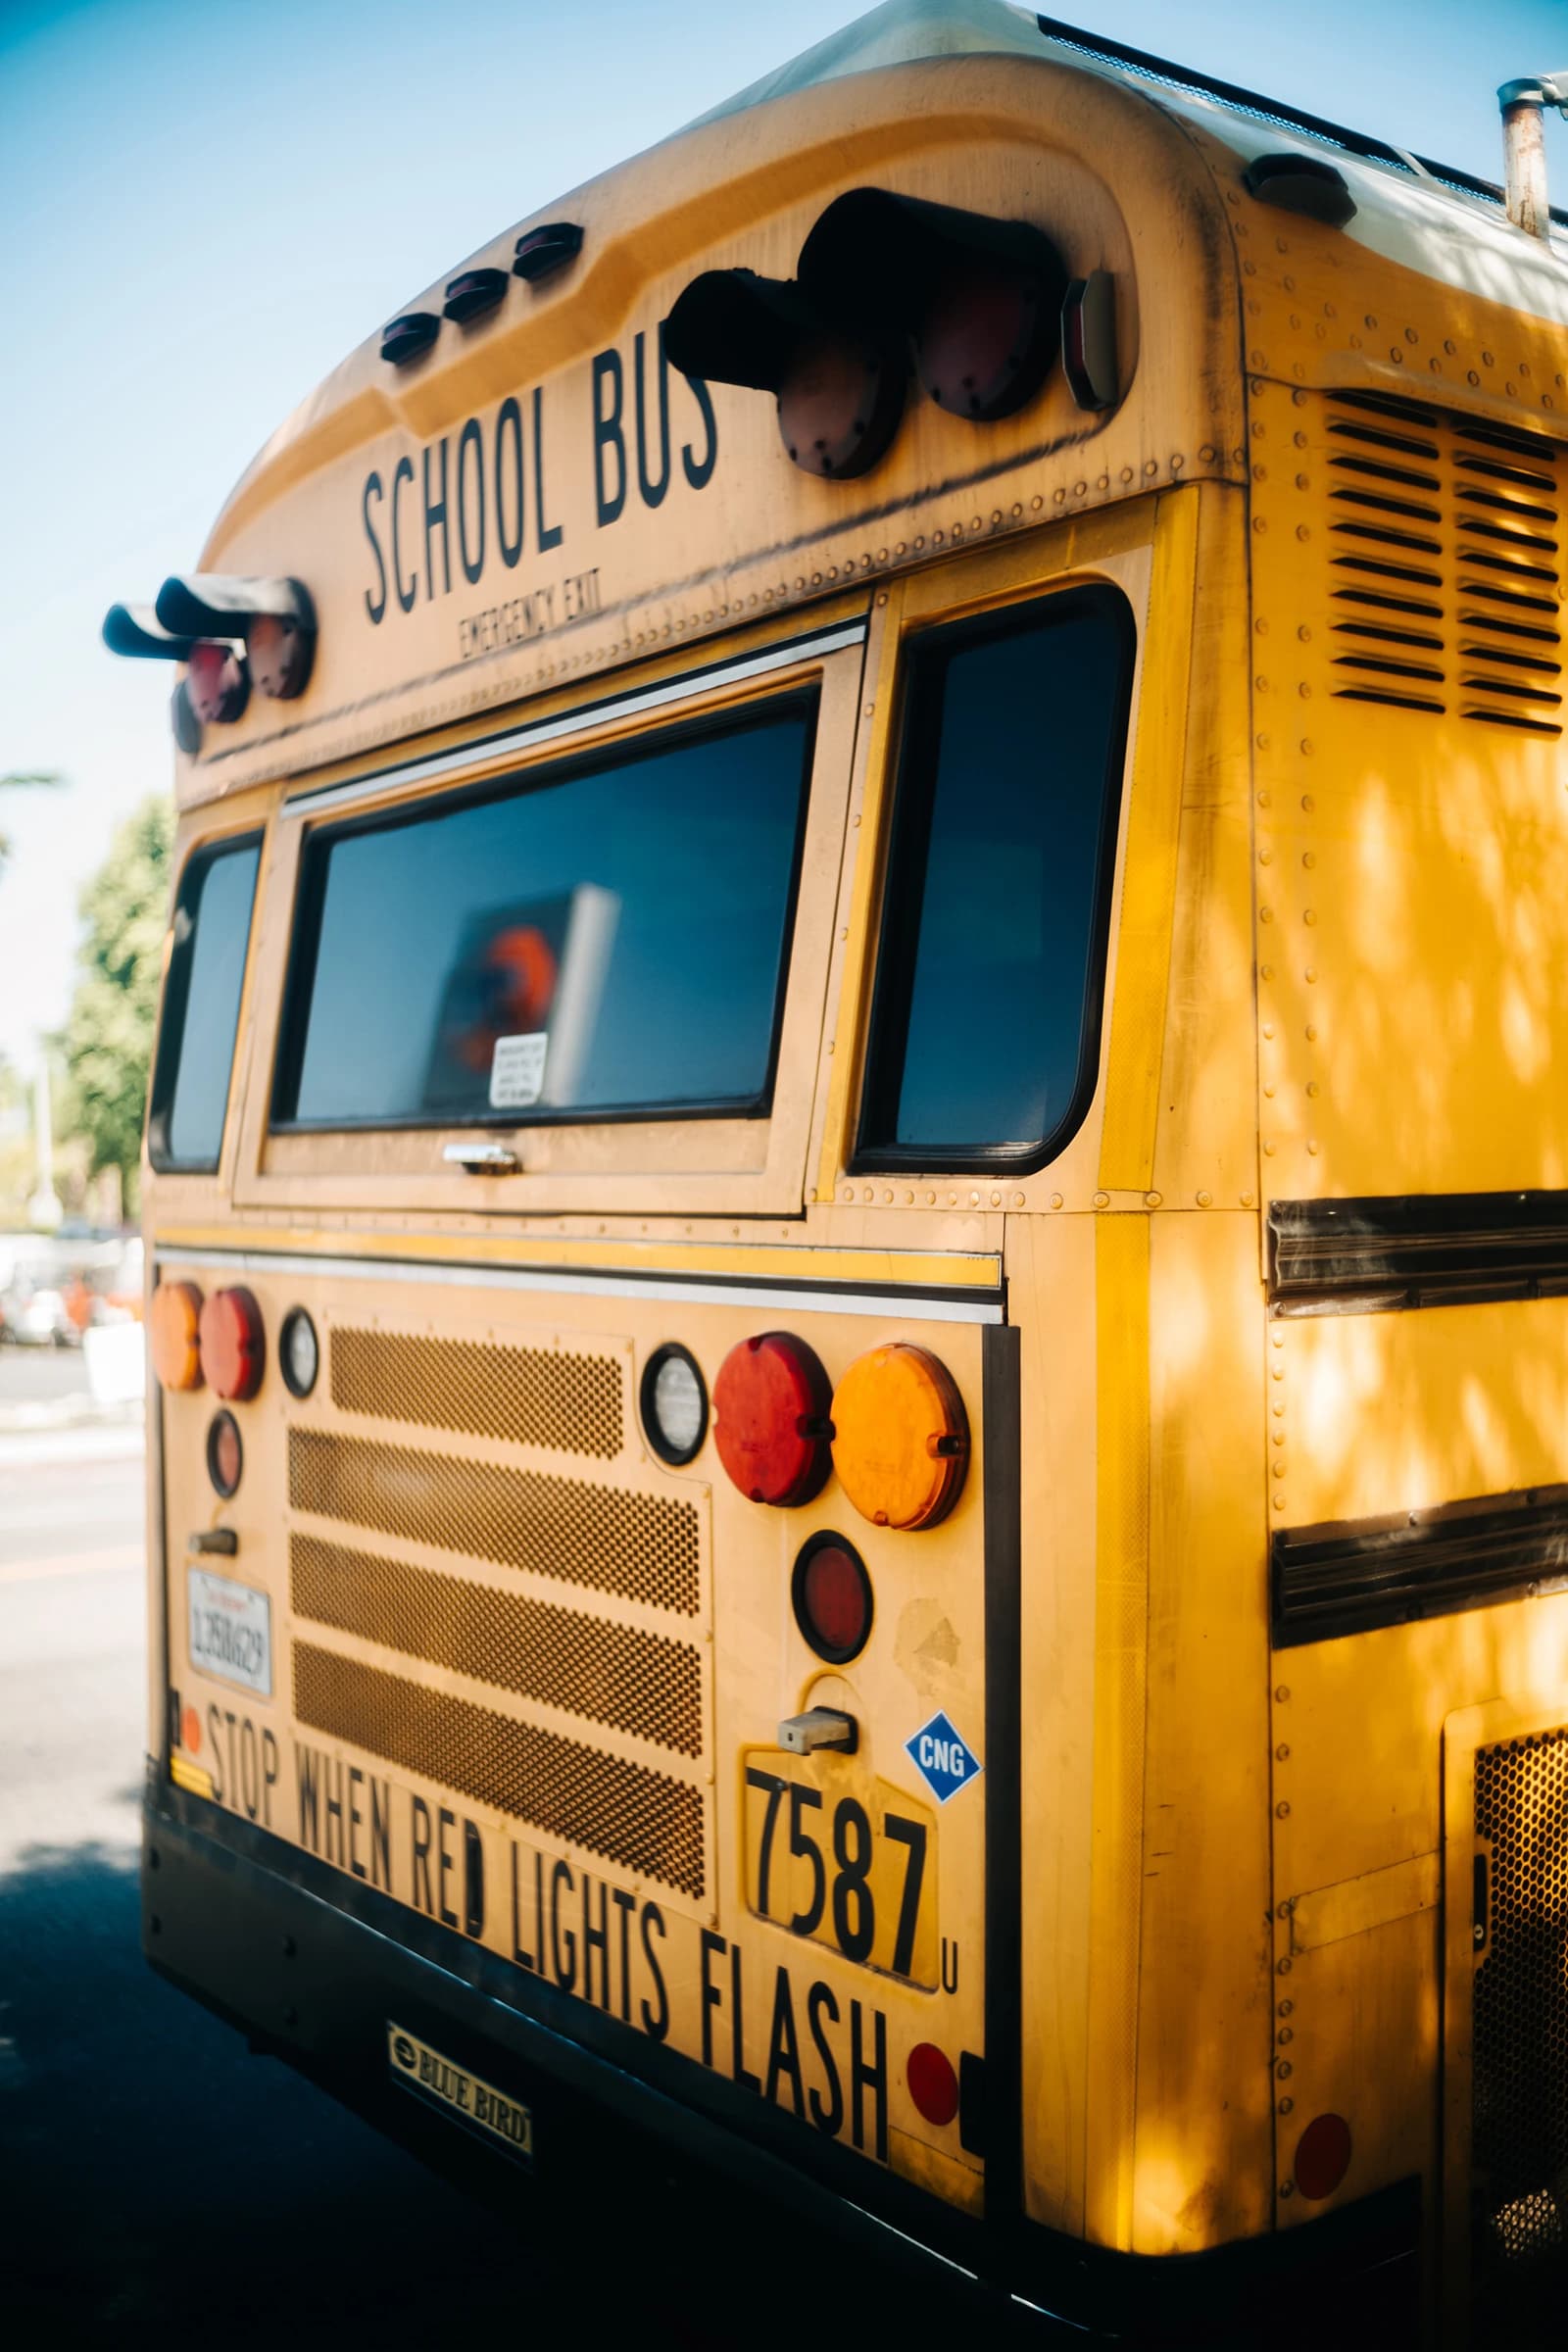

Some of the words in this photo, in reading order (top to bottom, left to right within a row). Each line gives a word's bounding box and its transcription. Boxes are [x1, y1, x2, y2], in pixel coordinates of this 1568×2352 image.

[363, 386, 564, 625] SCHOOL
[593, 319, 718, 528] BUS
[459, 585, 556, 660] EMERGENCY
[564, 567, 600, 621] EXIT
[918, 1735, 965, 1777] CNG
[745, 1766, 926, 1978] 7587
[207, 1702, 278, 1828] STOP
[295, 1740, 392, 1893] WHEN
[412, 1792, 486, 1940] RED
[512, 1840, 669, 2042] LIGHTS
[701, 1928, 889, 2164] FLASH
[942, 1937, 958, 1994] U
[419, 2047, 470, 2111] BLUE
[474, 2084, 526, 2144] BIRD
